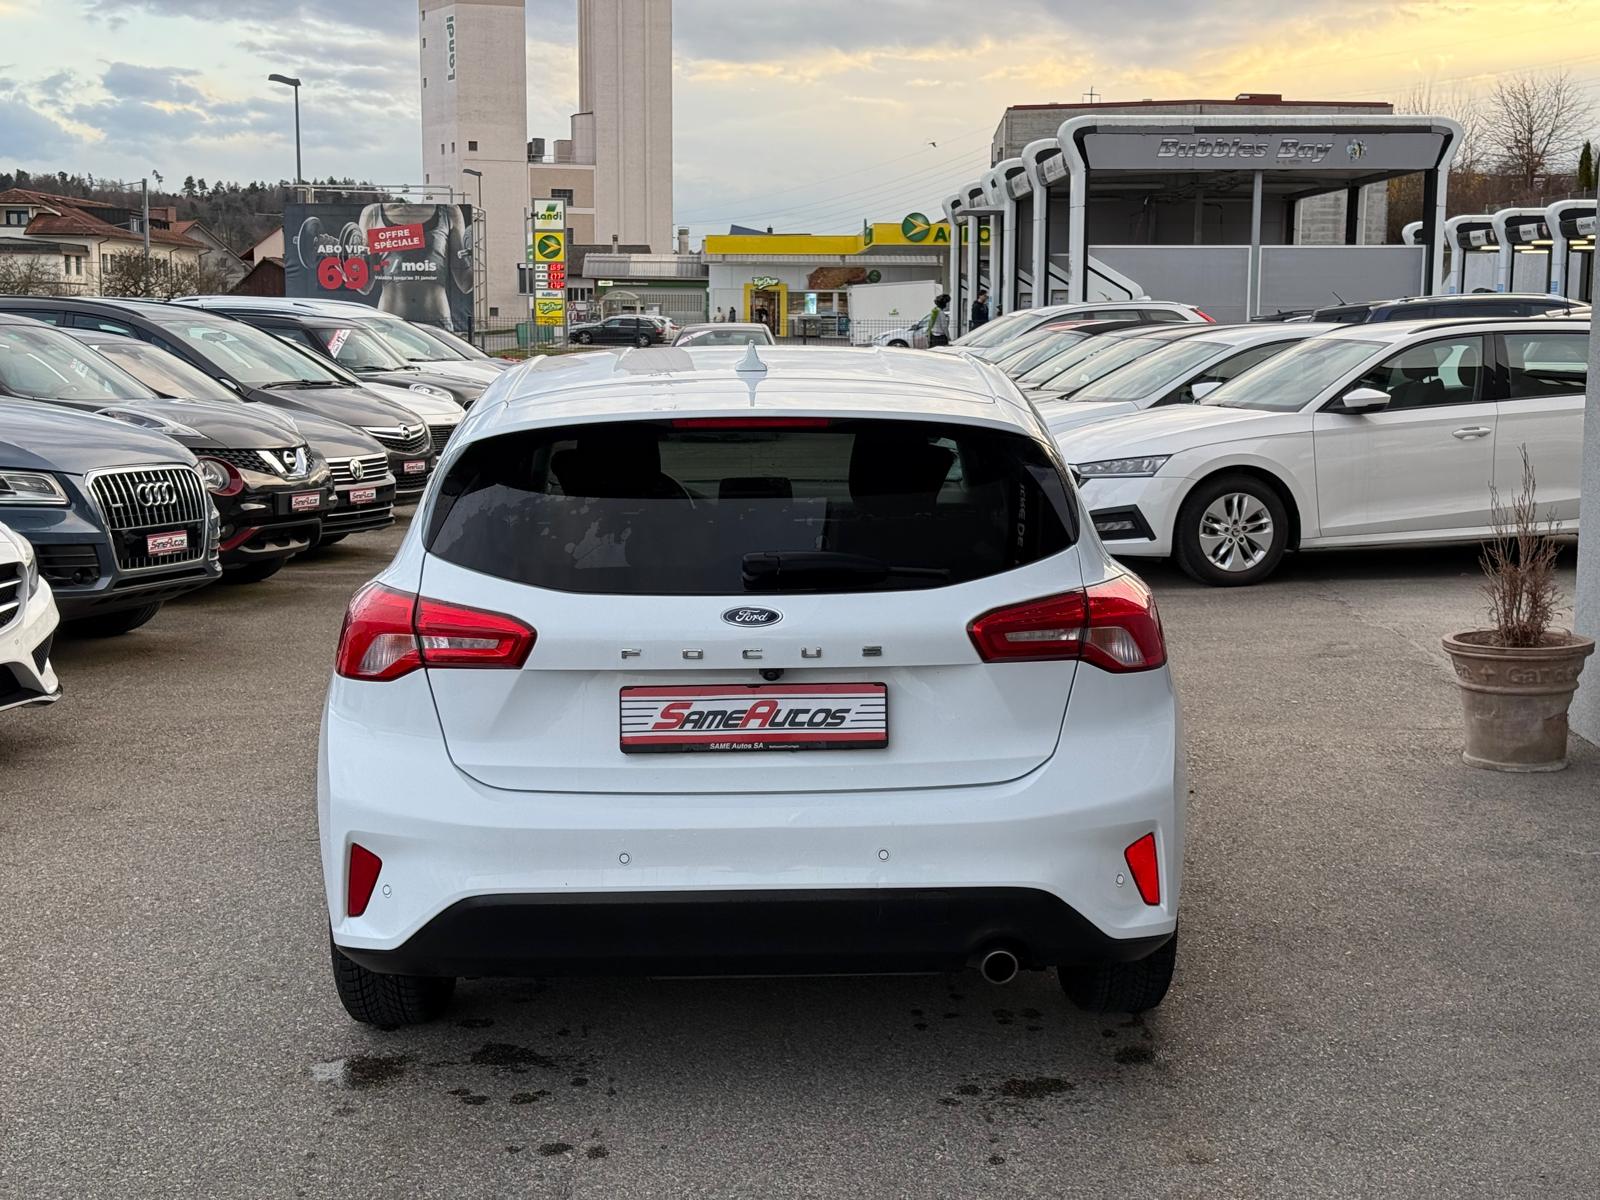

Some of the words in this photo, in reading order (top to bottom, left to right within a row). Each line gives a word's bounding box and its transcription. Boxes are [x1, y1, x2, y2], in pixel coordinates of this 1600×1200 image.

[446, 15, 455, 81] Landi
[1157, 137, 1268, 158] Bubbles
[1276, 138, 1334, 163] Bay
[536, 211, 562, 220] Landi
[378, 228, 410, 240] OFFRE
[317, 244, 342, 254] ABO
[373, 236, 420, 251] SPÉCIALE
[402, 258, 437, 272] mois
[735, 609, 768, 622] Ford
[621, 645, 883, 660] FOCUS
[709, 742, 730, 750] SAME
